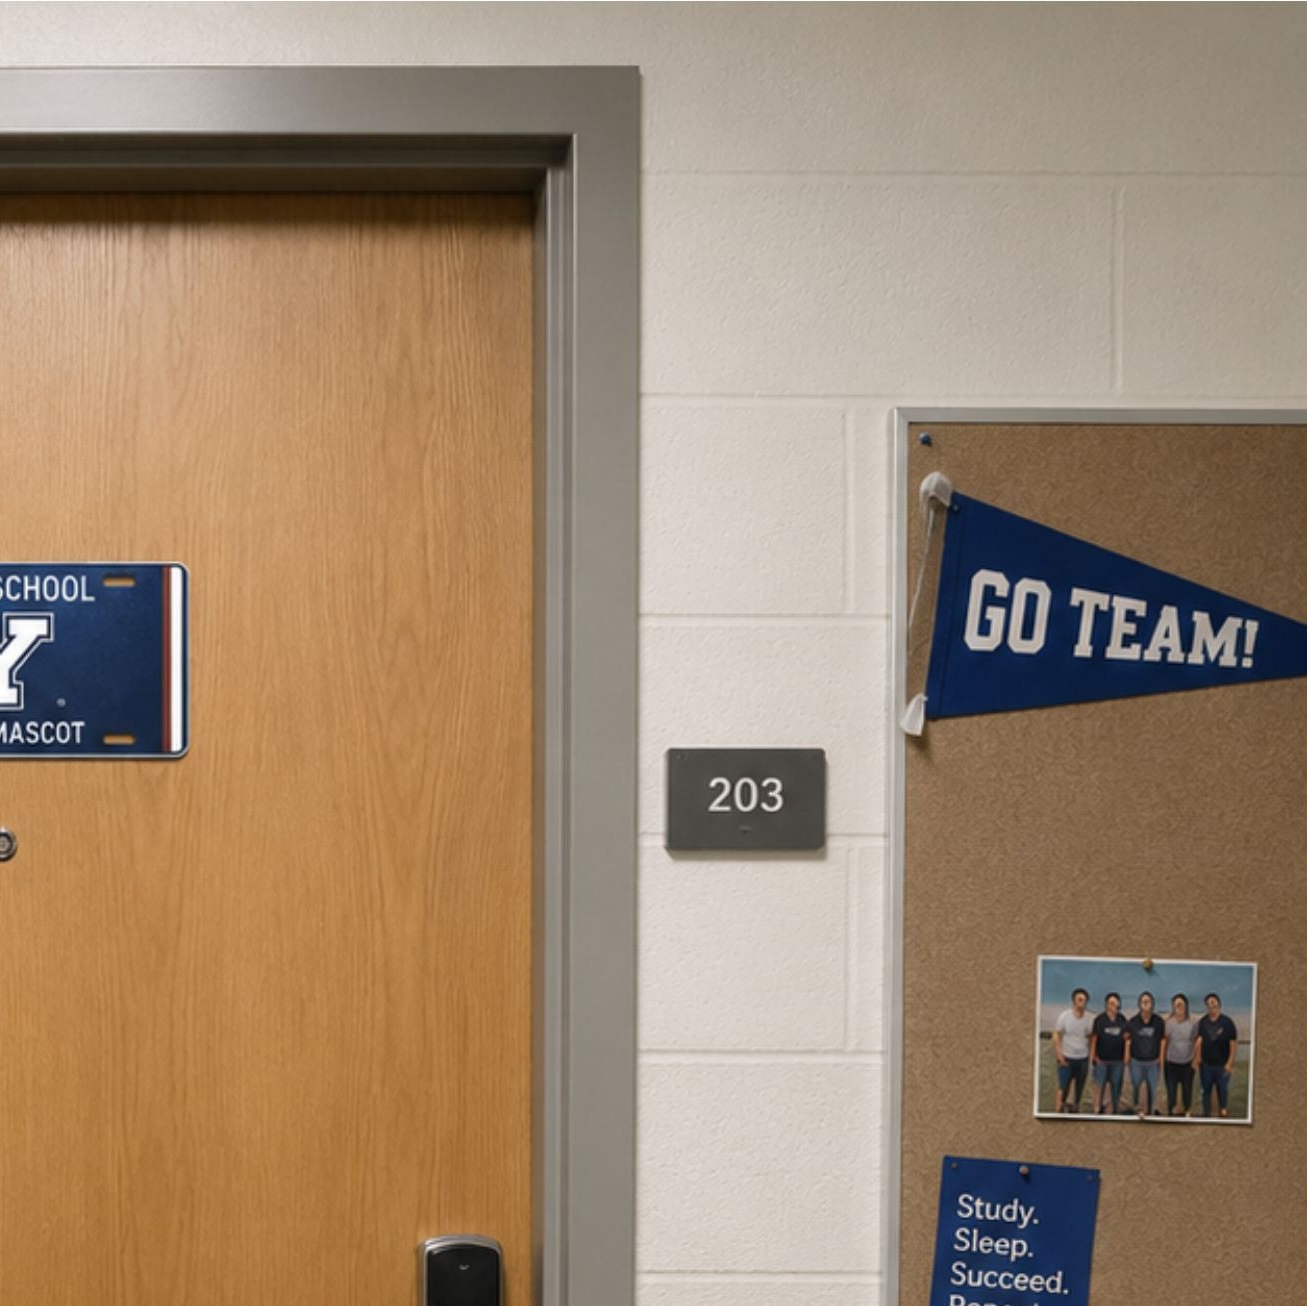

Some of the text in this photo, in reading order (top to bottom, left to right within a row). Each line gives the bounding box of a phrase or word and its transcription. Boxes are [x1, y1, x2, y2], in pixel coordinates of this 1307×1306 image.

[964, 568, 1259, 668] GO TEAM!
[708, 776, 784, 813] 203
[956, 1193, 1039, 1227] Study.
[954, 1227, 1034, 1261] Sleep.
[950, 1262, 1069, 1295] Succeed.
